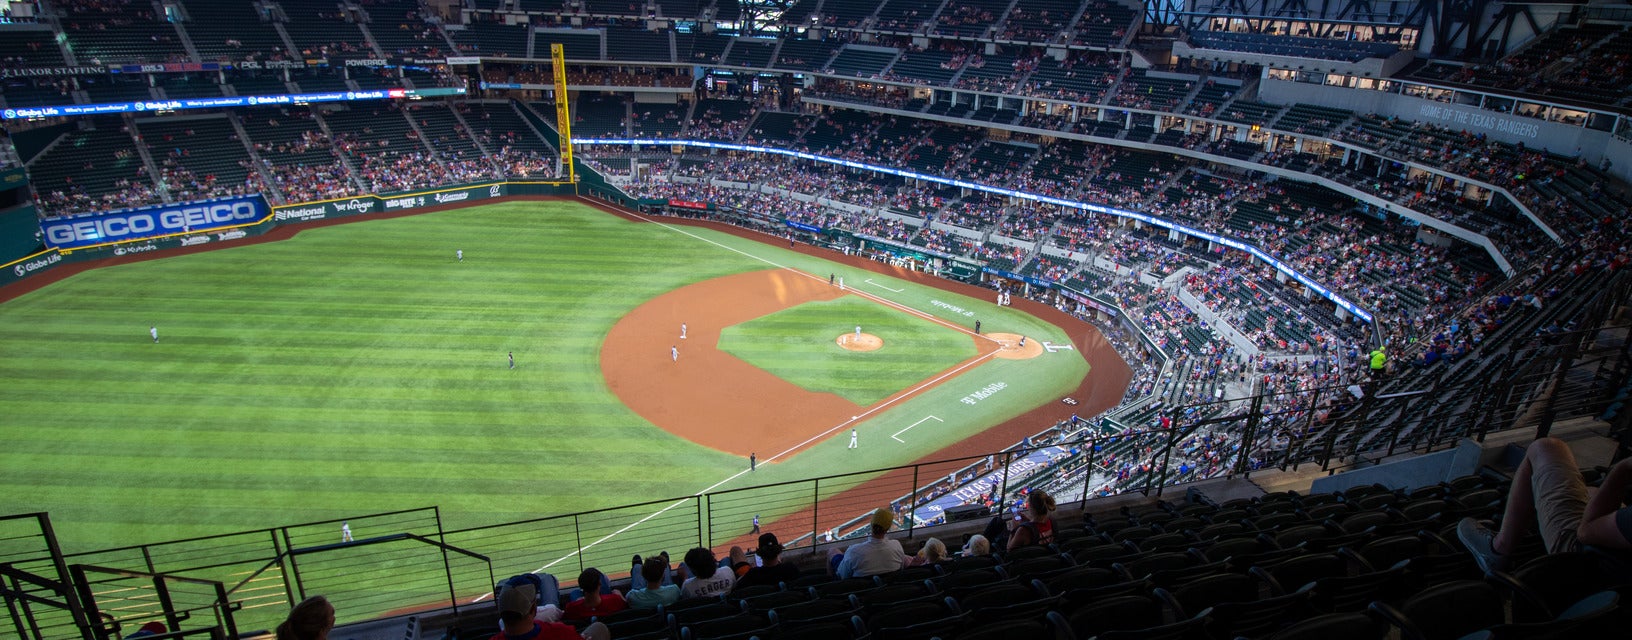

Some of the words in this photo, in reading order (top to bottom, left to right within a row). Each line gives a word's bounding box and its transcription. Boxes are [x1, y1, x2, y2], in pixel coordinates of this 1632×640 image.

[13, 68, 53, 76] LUXOR
[54, 66, 105, 75] STAFFING
[140, 64, 164, 72] 105.3
[17, 108, 42, 117] Globe
[42, 107, 58, 115] Life
[1420, 104, 1442, 118] HOME
[1442, 108, 1453, 120] OF
[1454, 110, 1469, 124] THE
[1470, 113, 1496, 130] TEXAS
[1497, 119, 1539, 138] RANGERS
[287, 206, 325, 219] National
[347, 199, 374, 213] Kroger
[47, 214, 155, 244] GEICO
[160, 201, 255, 229] GEICO
[25, 258, 48, 271] Globe
[49, 253, 62, 264] Life
[970, 381, 1008, 401] Mobile
[951, 479, 990, 501] TEXAS
[695, 579, 730, 595] SEAGER
